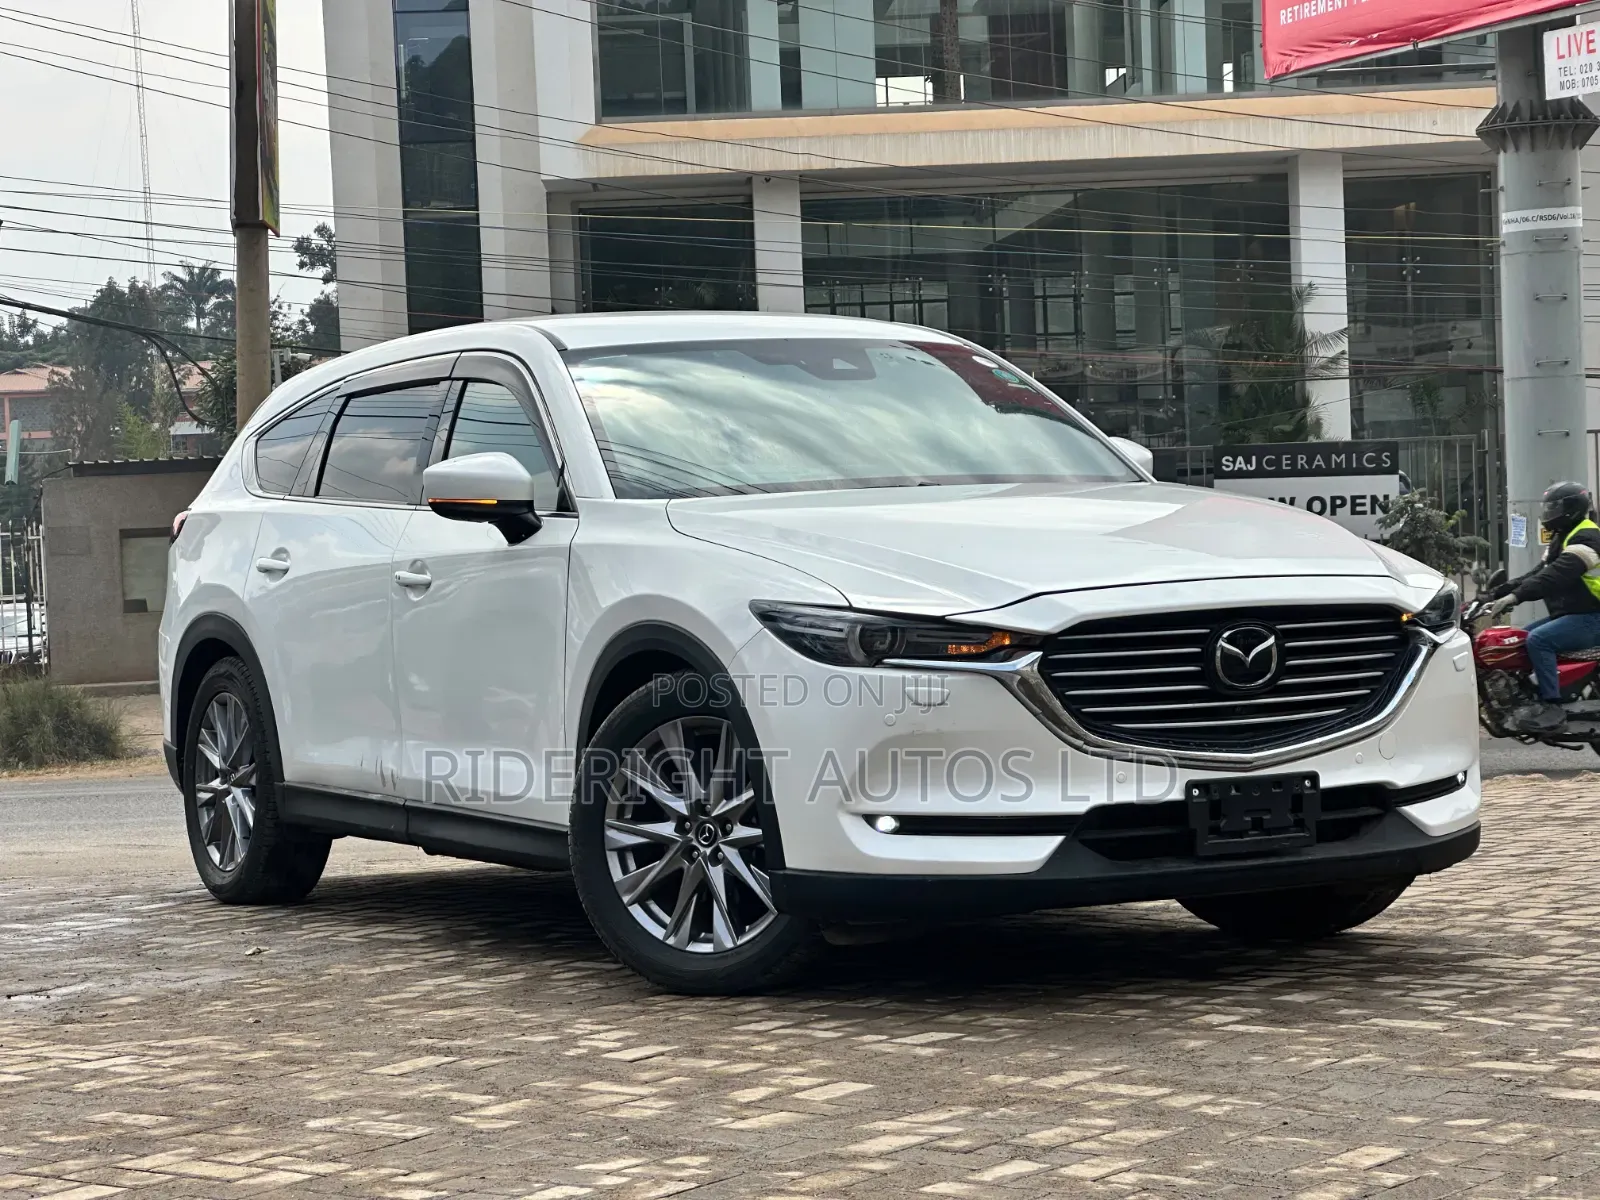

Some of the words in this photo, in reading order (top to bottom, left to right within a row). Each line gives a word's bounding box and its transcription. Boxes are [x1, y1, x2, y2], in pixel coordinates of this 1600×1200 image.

[1556, 29, 1597, 59] LIVE
[1558, 66, 1577, 78] TEL:
[1580, 63, 1593, 74] 020
[1559, 79, 1579, 91] MOB:
[1581, 75, 1599, 88] 0705
[1221, 455, 1257, 472] SAJ
[1262, 452, 1391, 471] CERAMICS
[1306, 494, 1390, 517] OPEN
